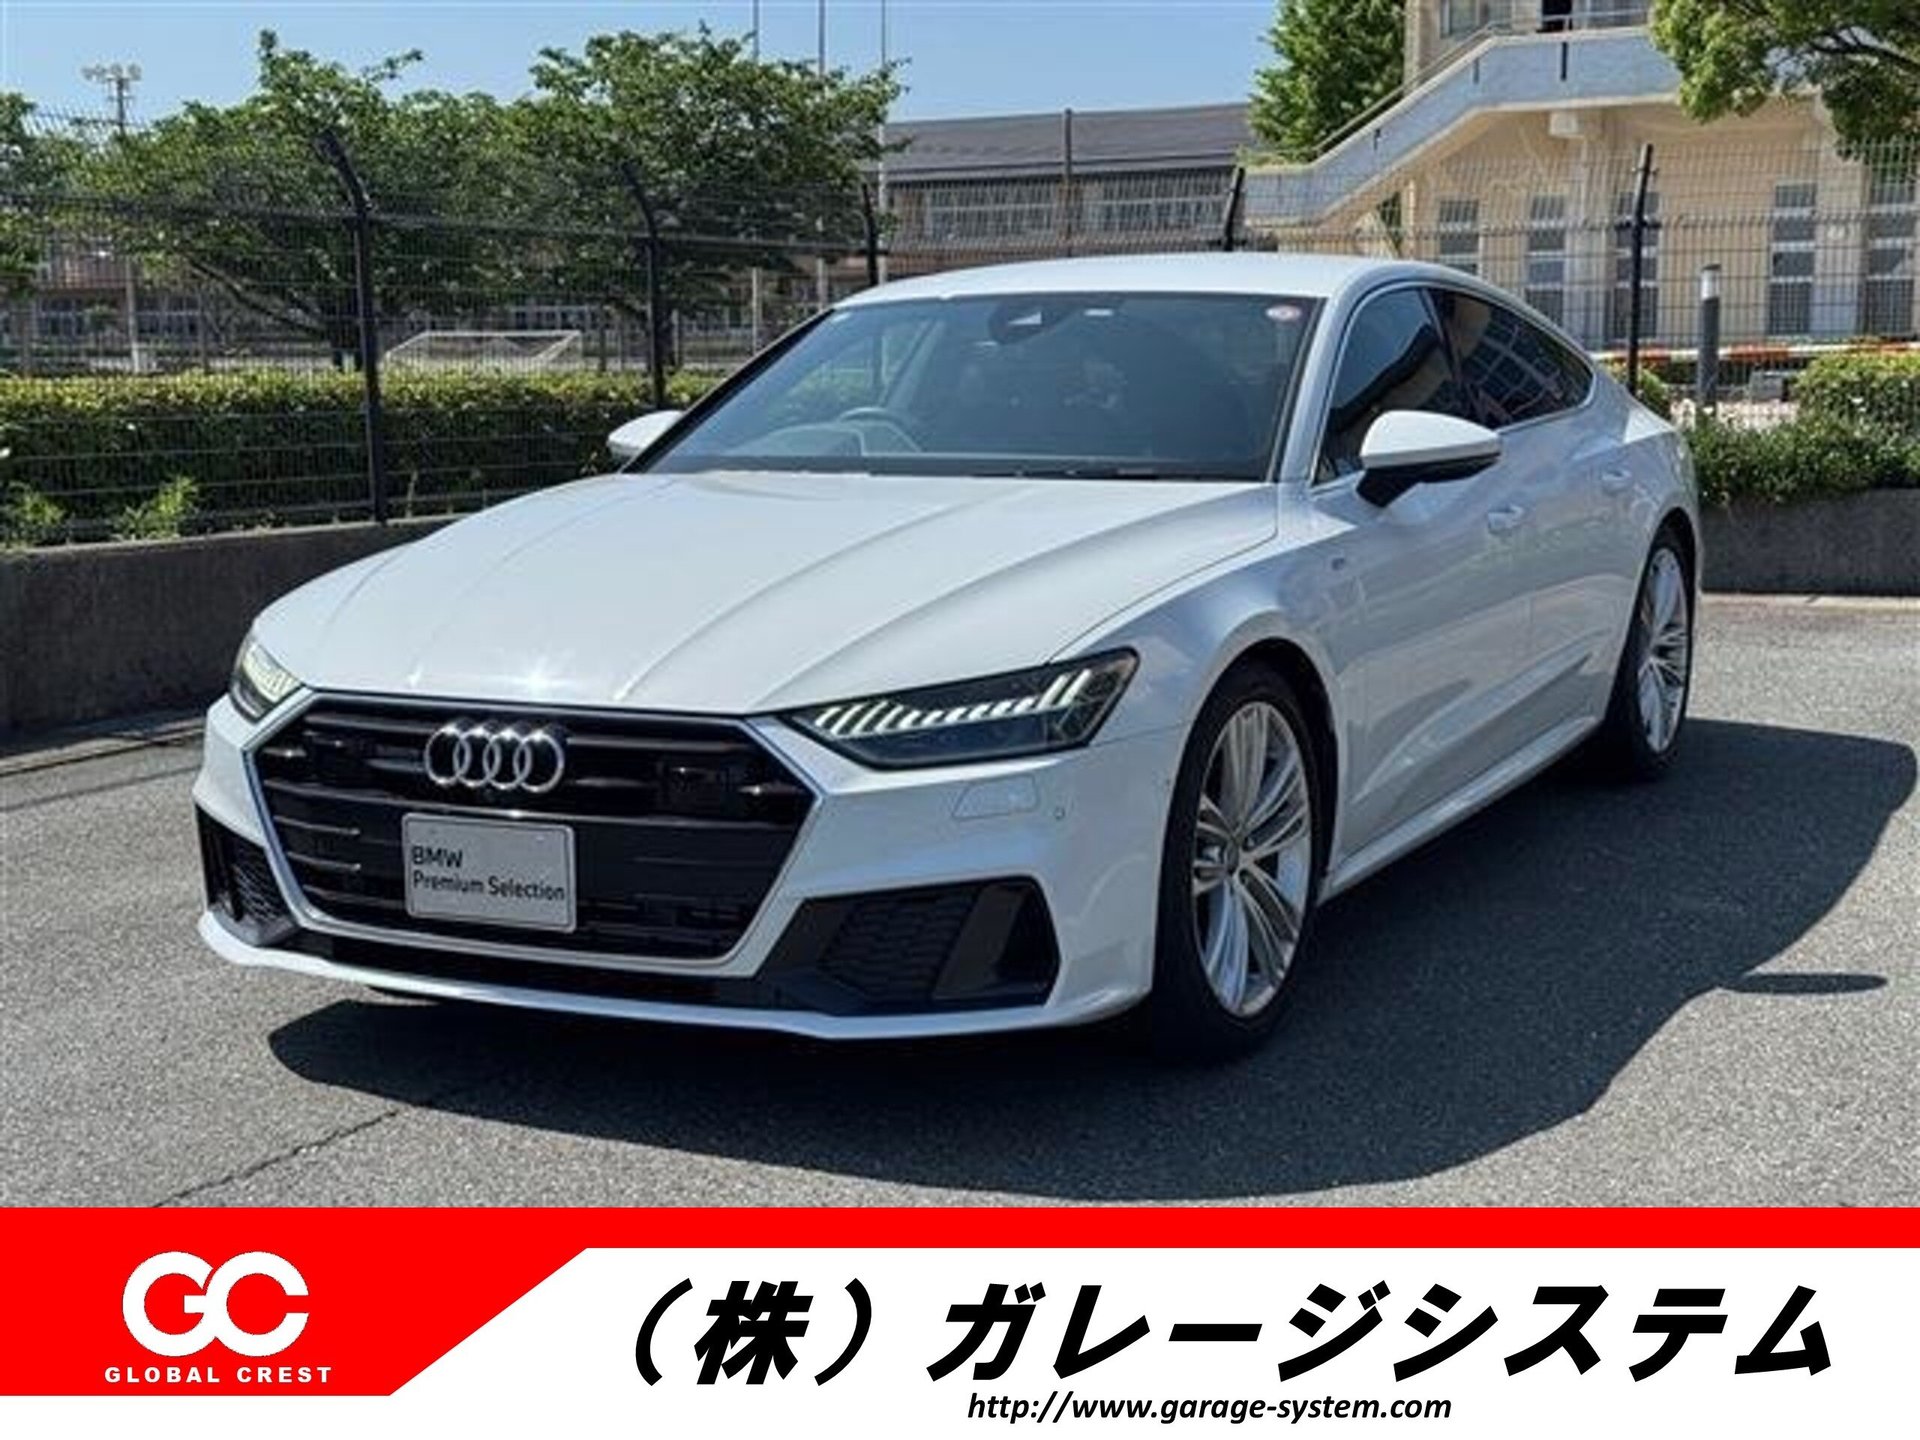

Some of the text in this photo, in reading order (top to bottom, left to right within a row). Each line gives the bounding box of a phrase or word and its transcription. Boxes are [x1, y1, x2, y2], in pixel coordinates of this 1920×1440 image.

[412, 845, 463, 868] BMW
[413, 869, 565, 901] Premium Selection
